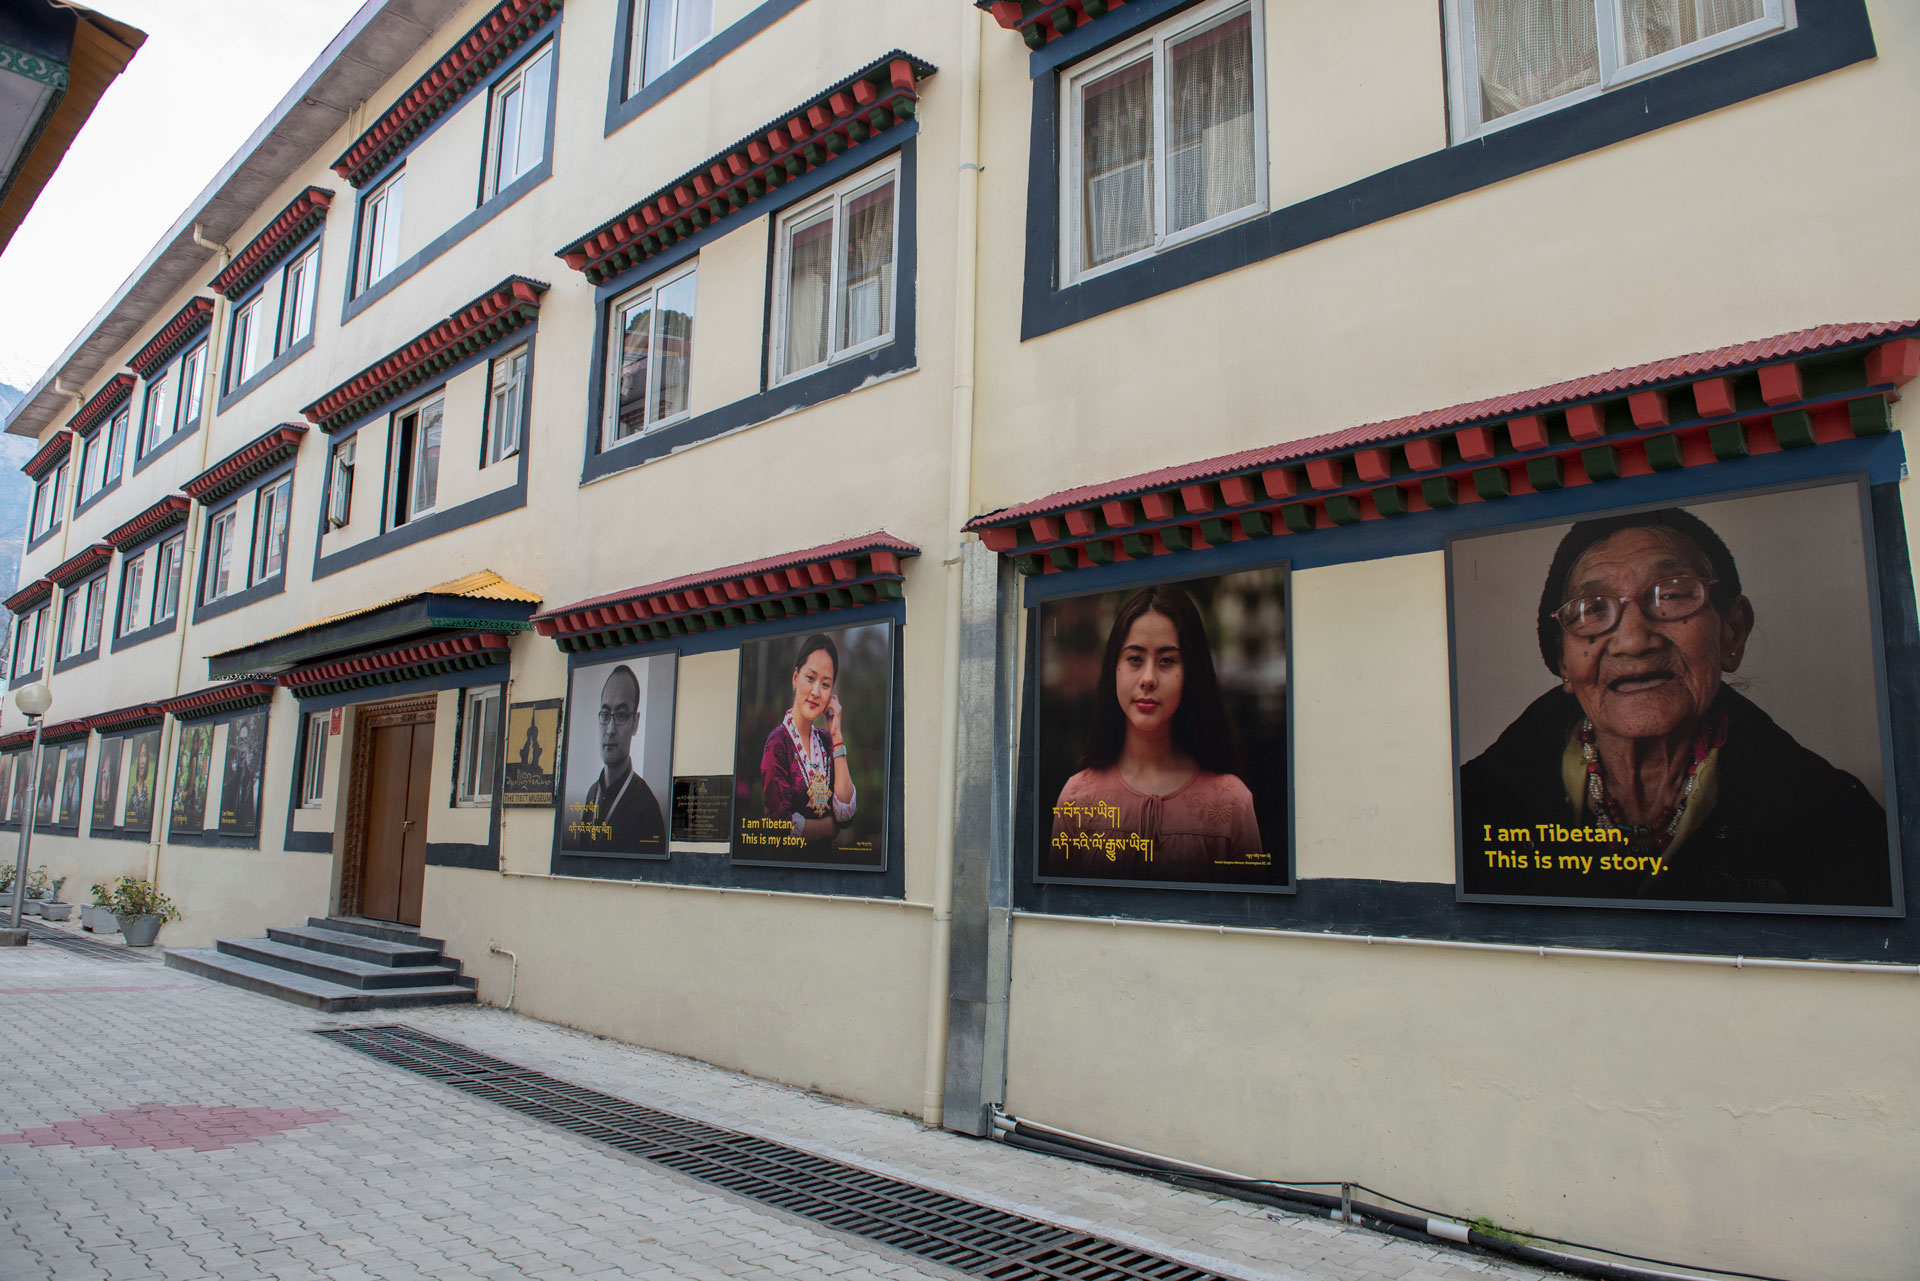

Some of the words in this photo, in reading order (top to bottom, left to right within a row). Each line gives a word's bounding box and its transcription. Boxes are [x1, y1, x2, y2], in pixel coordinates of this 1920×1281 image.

[504, 794, 514, 803] THE
[515, 794, 528, 803] TIBET
[529, 794, 552, 803] MUSEUM
[742, 818, 746, 829] I
[747, 820, 760, 829] am
[762, 818, 794, 831] Tibetan,
[742, 833, 758, 845] This
[759, 833, 767, 846] is
[768, 836, 781, 848] my
[783, 836, 807, 849] story.
[1484, 824, 1492, 842] I
[1498, 827, 1531, 842] am
[1535, 823, 1629, 846] Tibetan,
[1485, 850, 1529, 869] This
[1534, 850, 1553, 870] is
[1558, 855, 1593, 875] my
[1600, 852, 1669, 876] story.
